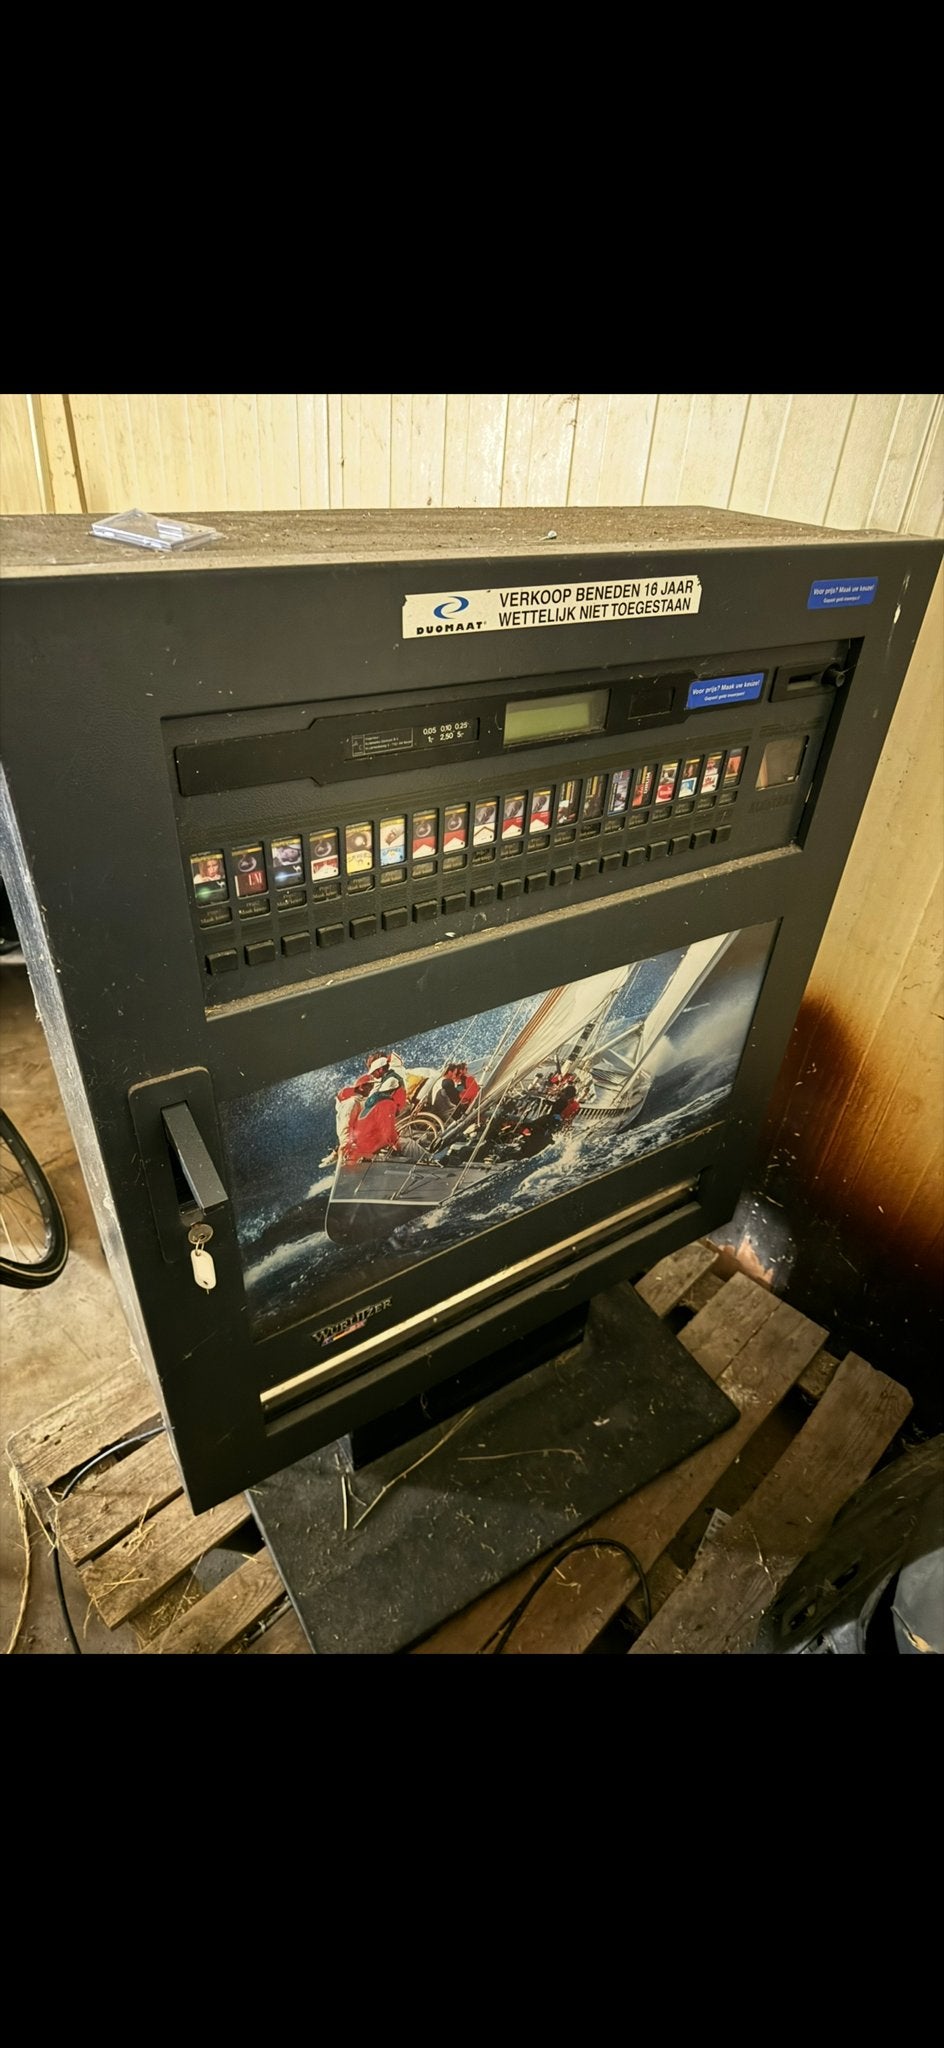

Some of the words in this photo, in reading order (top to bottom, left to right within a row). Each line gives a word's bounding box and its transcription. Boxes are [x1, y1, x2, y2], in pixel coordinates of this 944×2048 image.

[500, 588, 572, 607] VERKOOP
[576, 583, 641, 600] BENEDEN
[644, 582, 658, 597] 16
[660, 580, 694, 595] JAAR
[499, 607, 577, 627] WETTELIJK
[579, 605, 611, 620] NIET
[611, 598, 692, 618] TOEGESTAAN
[416, 621, 483, 635] DUOMAAT
